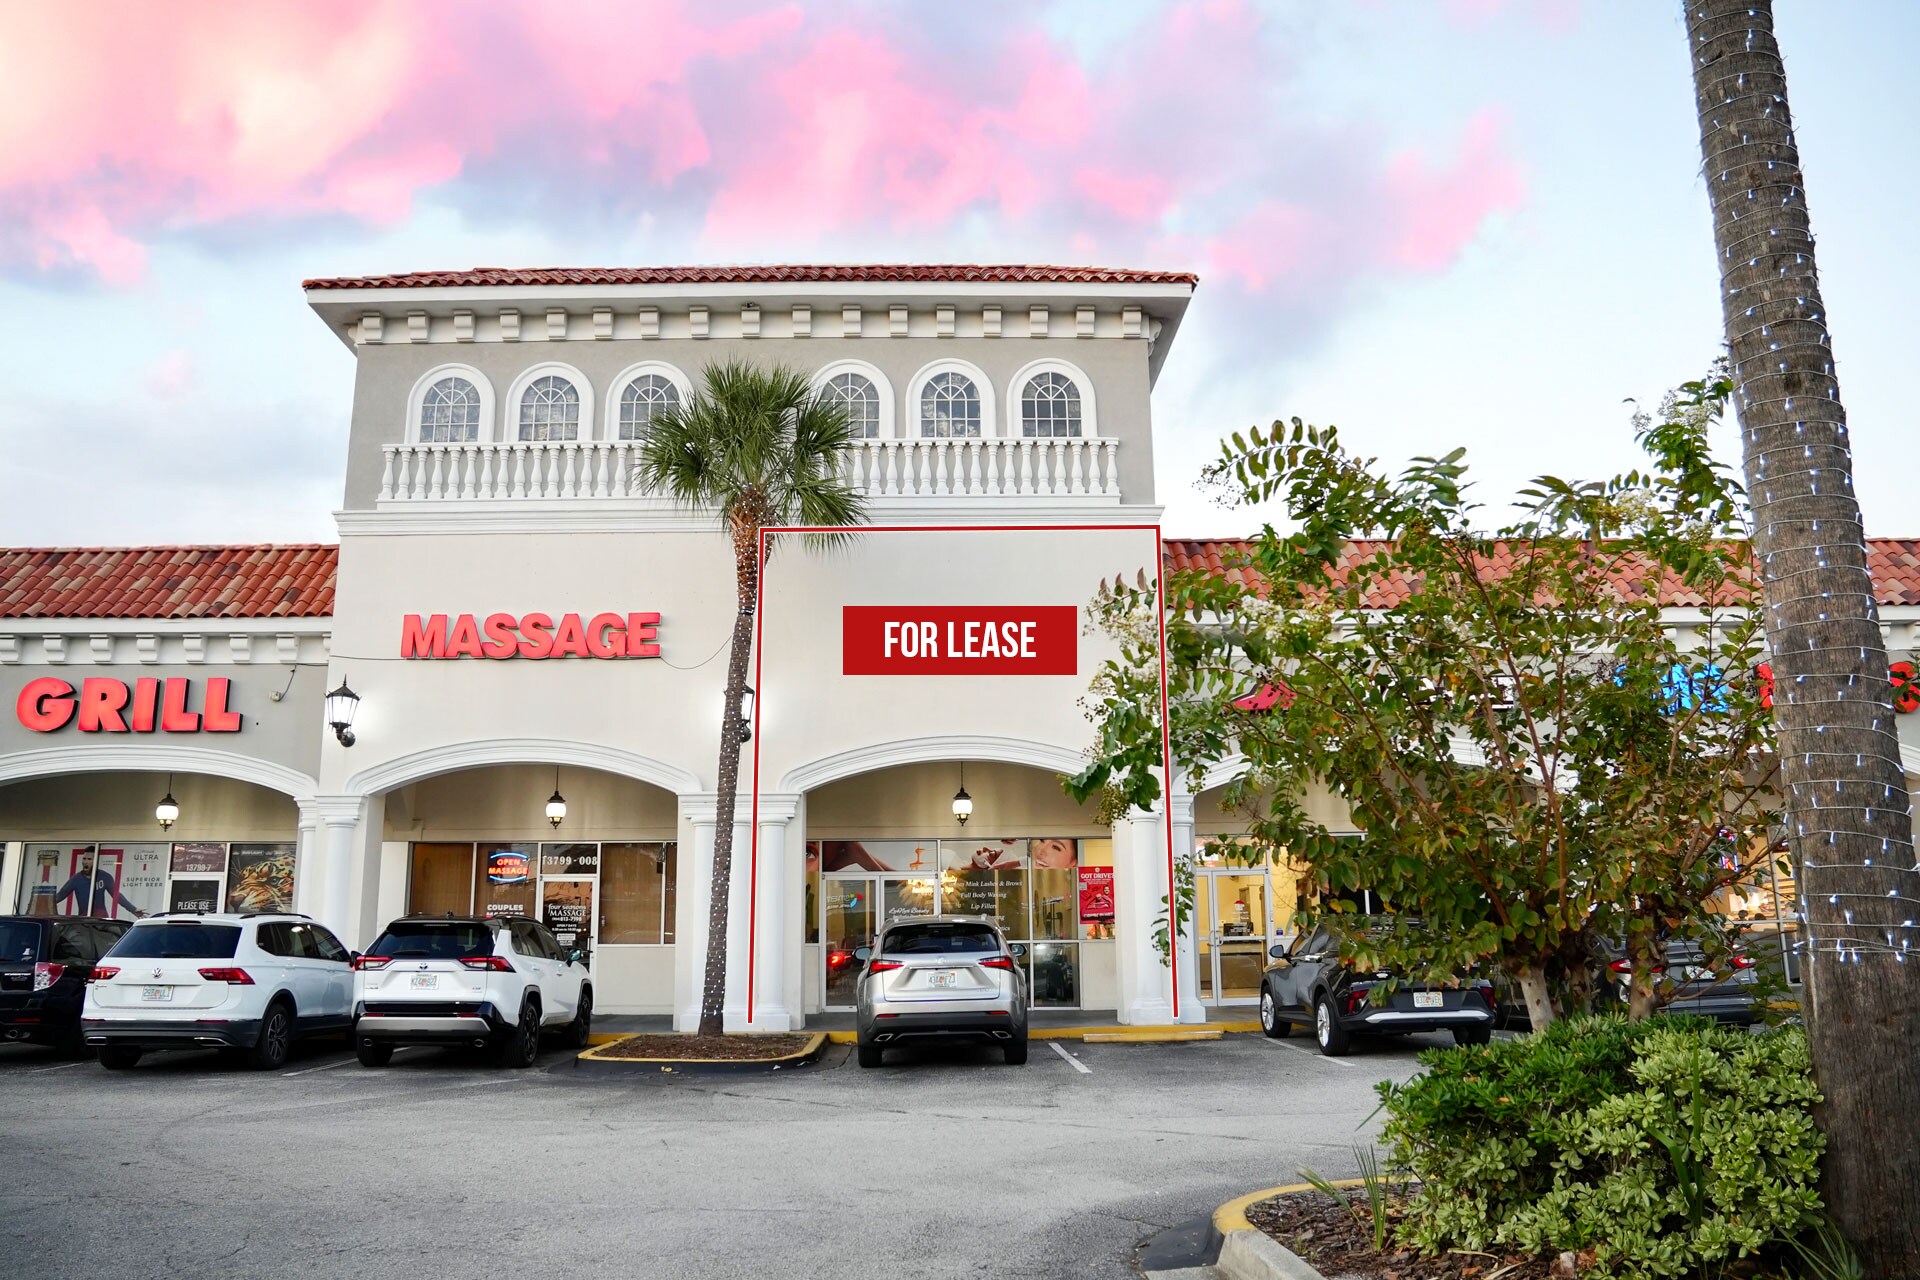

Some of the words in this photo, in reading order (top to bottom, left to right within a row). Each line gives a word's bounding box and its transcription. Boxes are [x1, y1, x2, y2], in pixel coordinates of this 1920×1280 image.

[400, 612, 662, 659] MASSAGE
[15, 676, 243, 732] GRILL
[496, 858, 521, 866] OPEN
[488, 867, 528, 875] MASSAGE
[177, 901, 197, 911] PLEASE
[198, 902, 210, 910] USE
[548, 903, 561, 914] four
